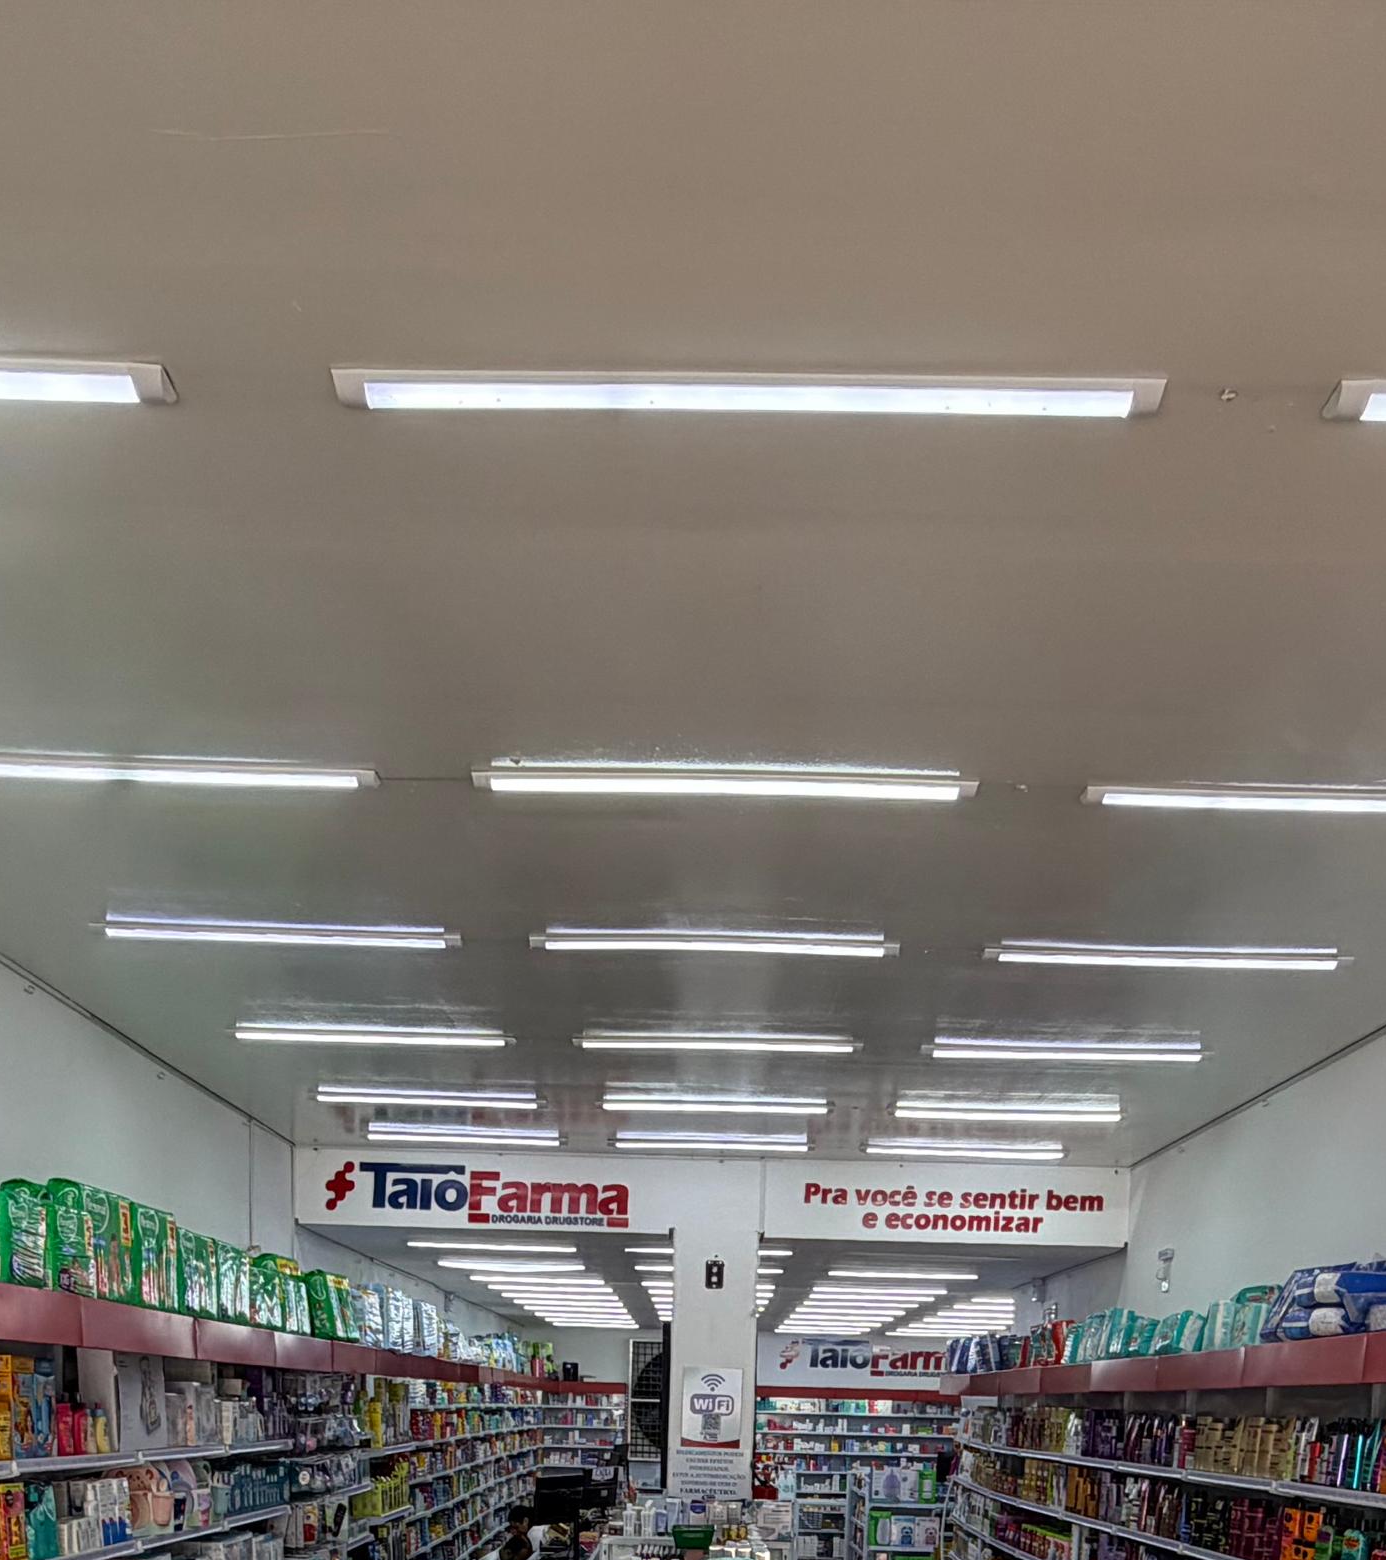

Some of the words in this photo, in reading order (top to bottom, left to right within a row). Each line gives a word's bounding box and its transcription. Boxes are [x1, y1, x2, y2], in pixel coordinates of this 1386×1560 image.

[804, 1183, 848, 1205] Pra
[855, 1186, 917, 1207] você
[924, 1189, 953, 1208] se
[959, 1188, 1040, 1211] sentir
[1046, 1189, 1104, 1212] bem
[492, 1214, 543, 1225] DROGARIA
[545, 1215, 605, 1228] DRUGSTORE
[862, 1212, 879, 1229] e
[885, 1211, 1044, 1233] economizar
